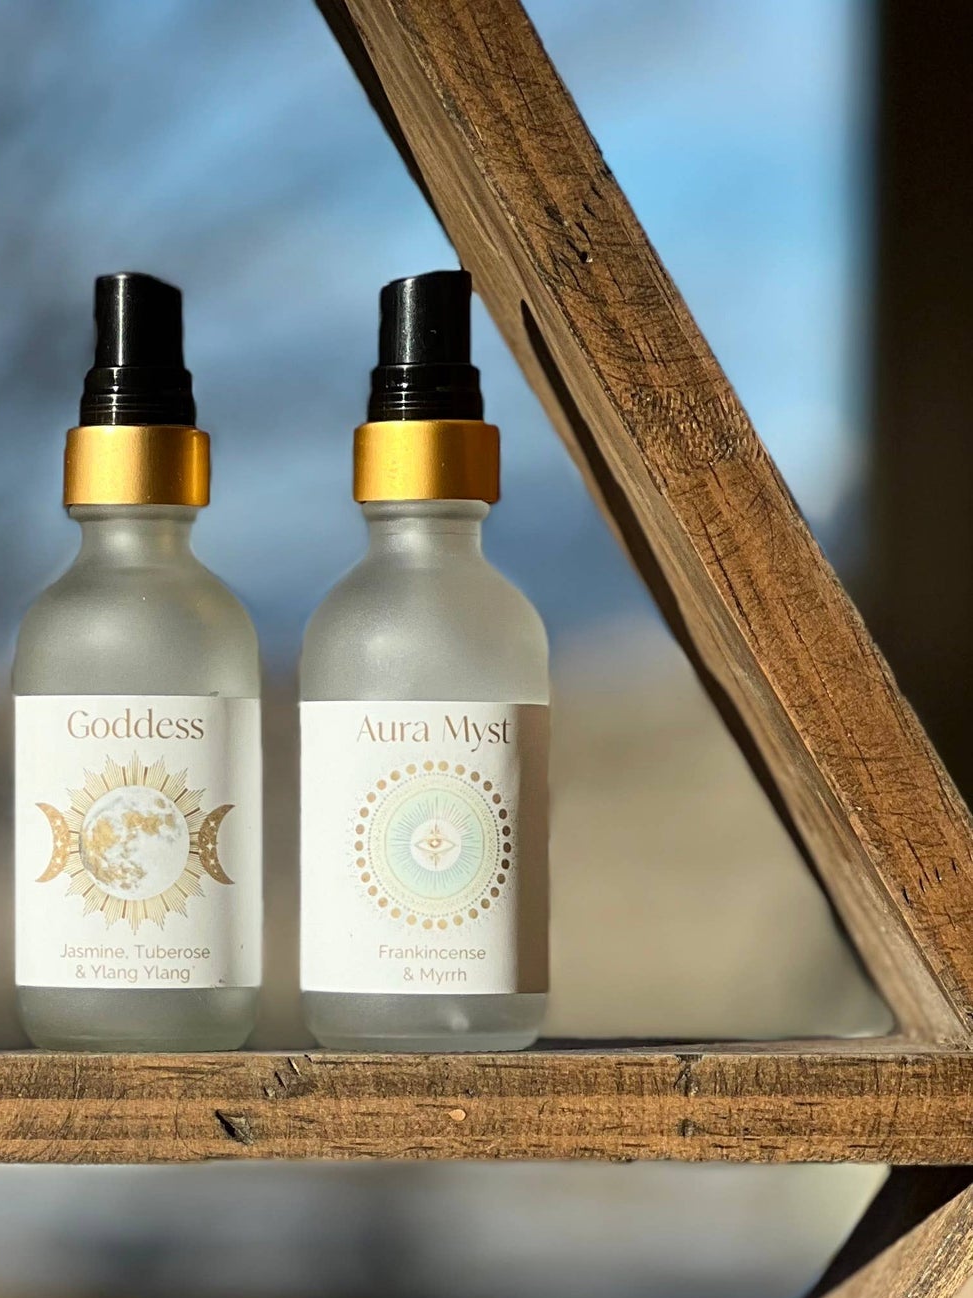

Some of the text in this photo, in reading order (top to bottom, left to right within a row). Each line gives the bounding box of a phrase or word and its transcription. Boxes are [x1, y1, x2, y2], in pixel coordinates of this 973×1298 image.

[67, 708, 204, 739] Goddess
[357, 714, 512, 752] Aura Myst
[134, 945, 210, 959] Tuberose
[379, 945, 486, 959] Frankincense
[76, 966, 86, 979] &
[91, 965, 138, 982] Ylang
[404, 968, 467, 985] & Myrrh
